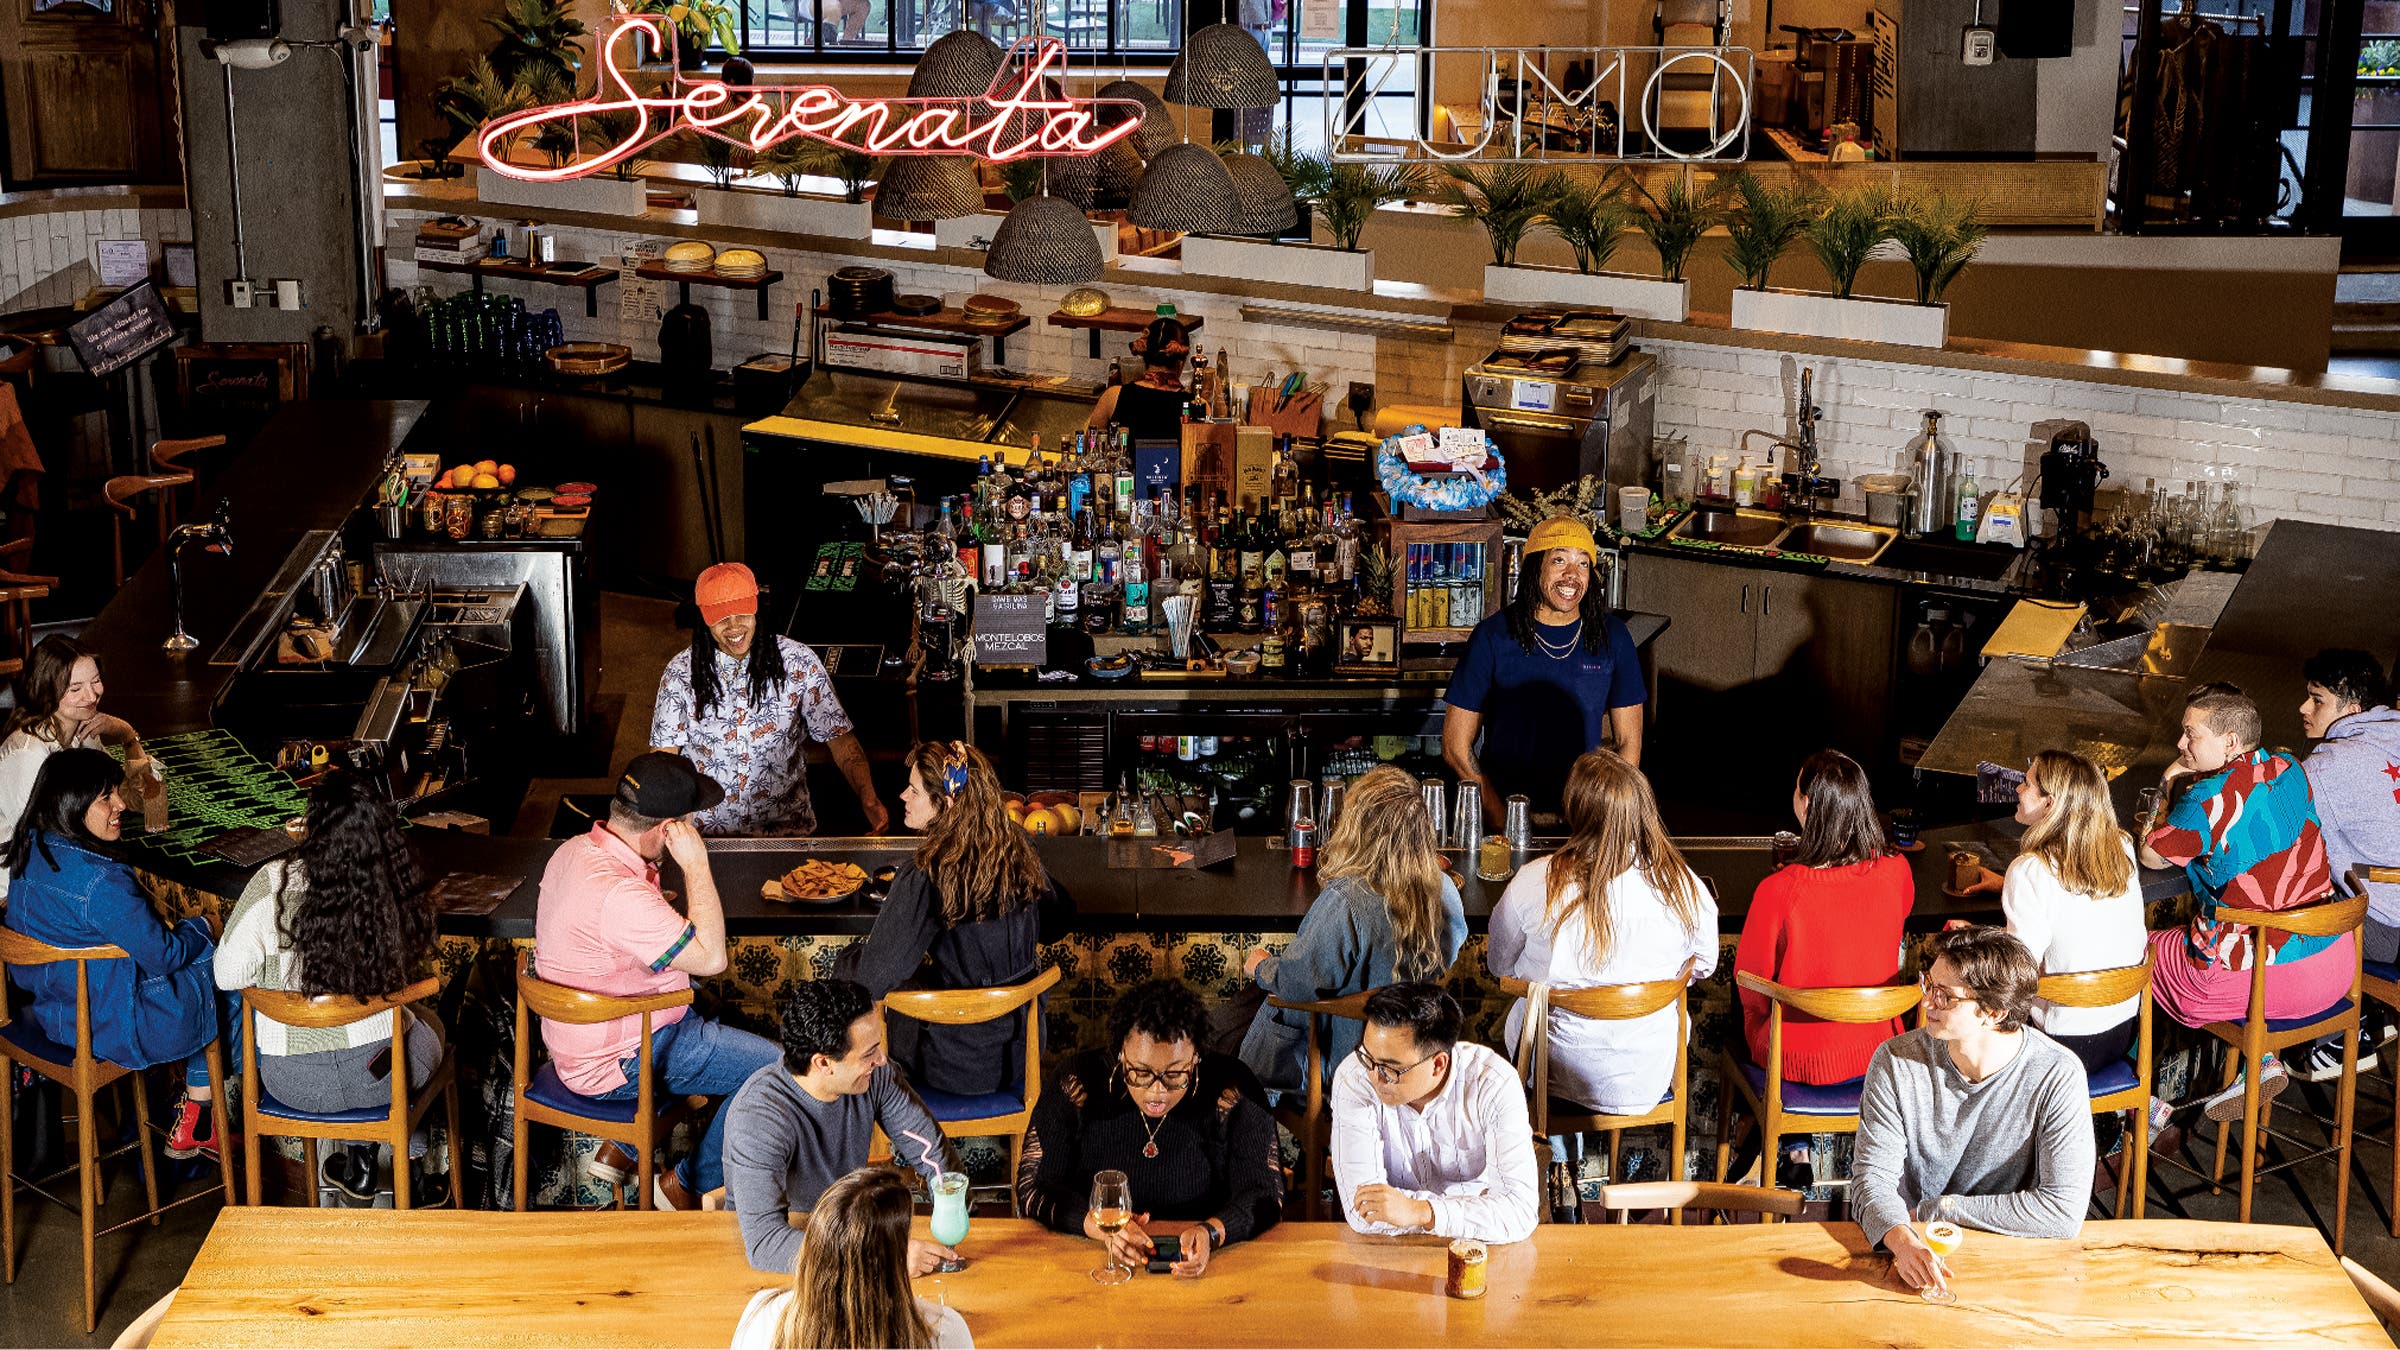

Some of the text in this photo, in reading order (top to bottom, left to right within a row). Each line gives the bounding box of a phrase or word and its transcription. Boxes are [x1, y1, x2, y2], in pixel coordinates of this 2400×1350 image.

[480, 18, 1142, 180] Serenata
[1329, 50, 1748, 160] ZUMO
[100, 326, 113, 337] are
[114, 311, 138, 330] closed
[103, 330, 129, 349] private
[975, 633, 1046, 642] MONTELOBOS
[985, 641, 1029, 651] MEZCAL
